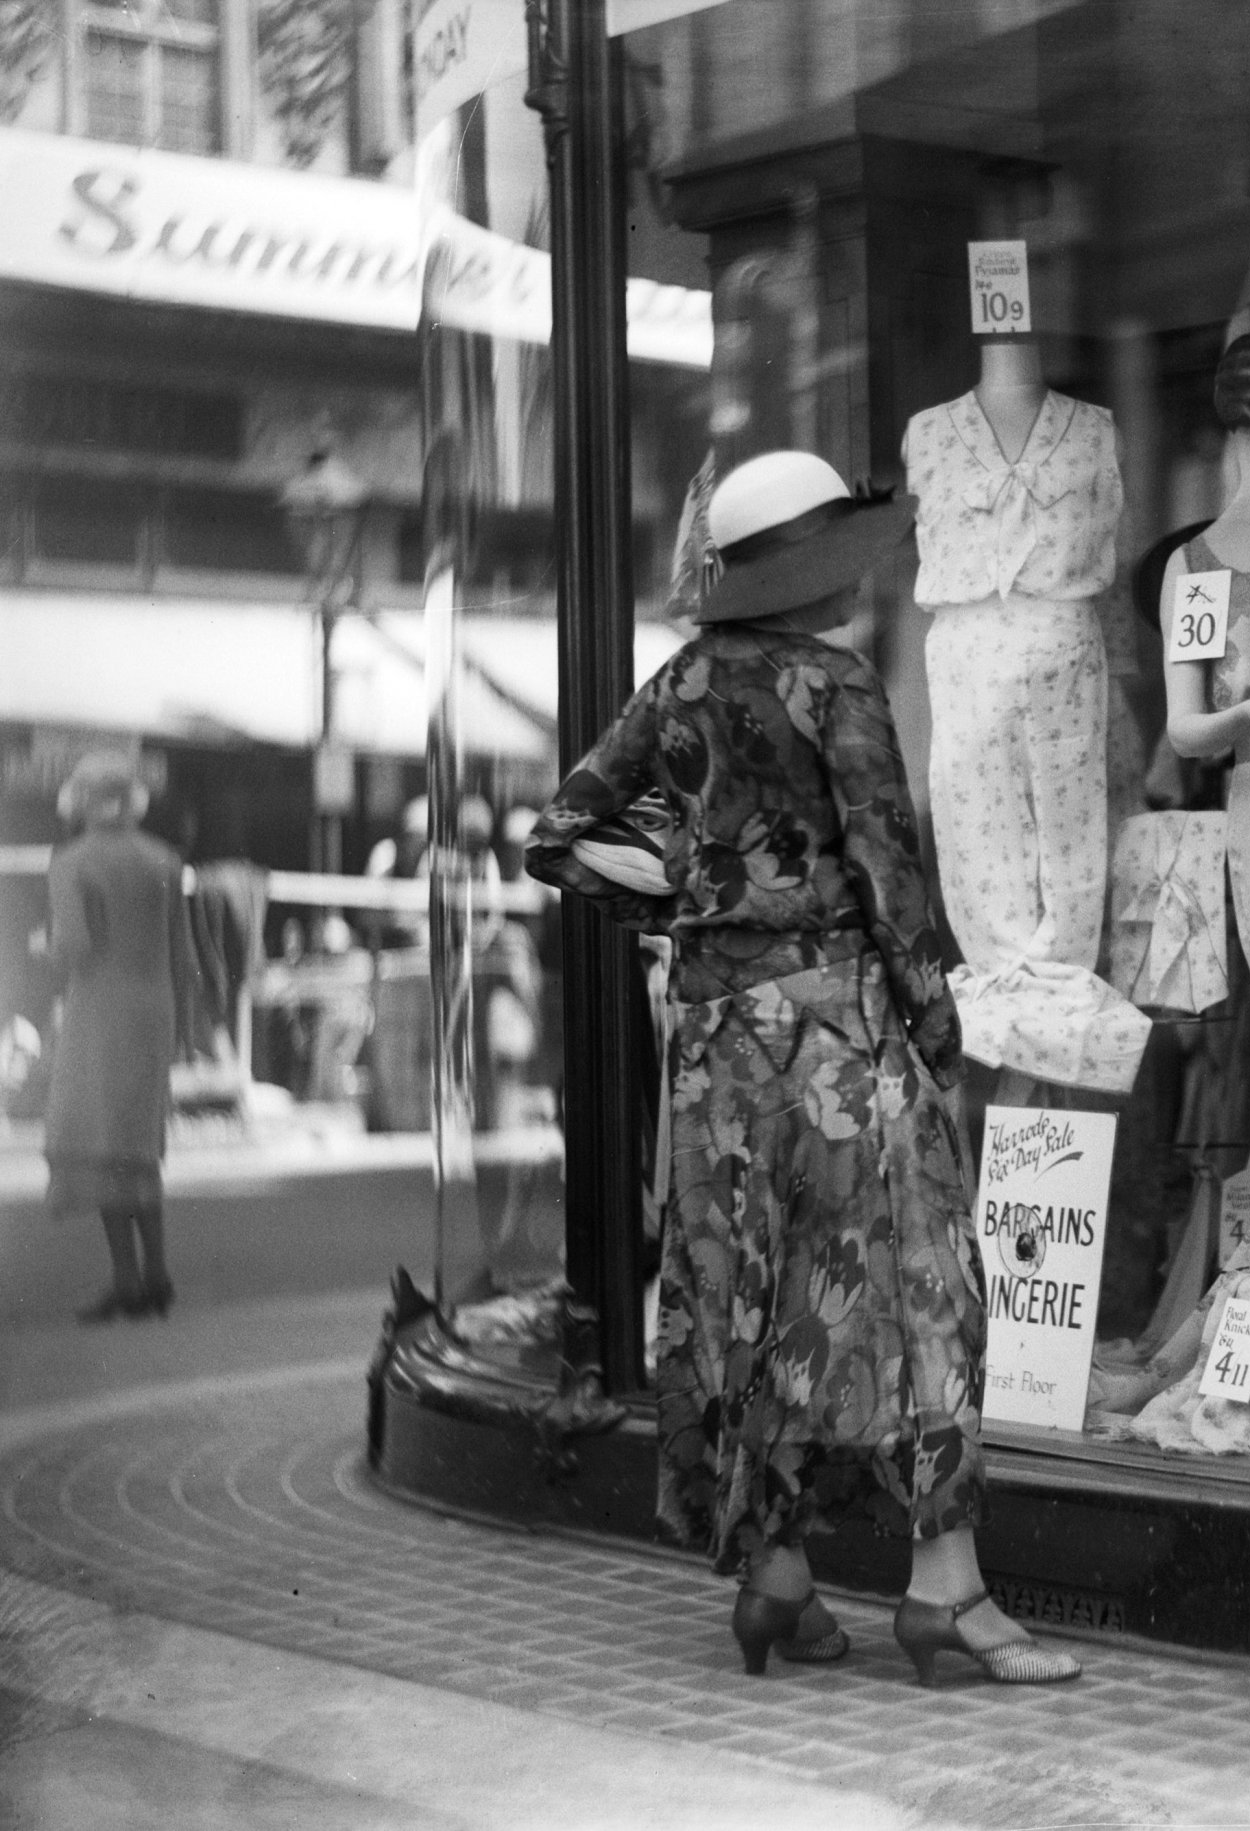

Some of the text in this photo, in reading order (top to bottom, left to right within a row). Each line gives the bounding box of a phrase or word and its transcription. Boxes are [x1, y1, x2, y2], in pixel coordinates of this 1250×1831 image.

[1178, 612, 1216, 648] 30
[1011, 1146, 1042, 1173] Day
[1043, 1121, 1075, 1156] Sale
[988, 1274, 1086, 1330] INGERIE
[1021, 1370, 1057, 1395] Floor
